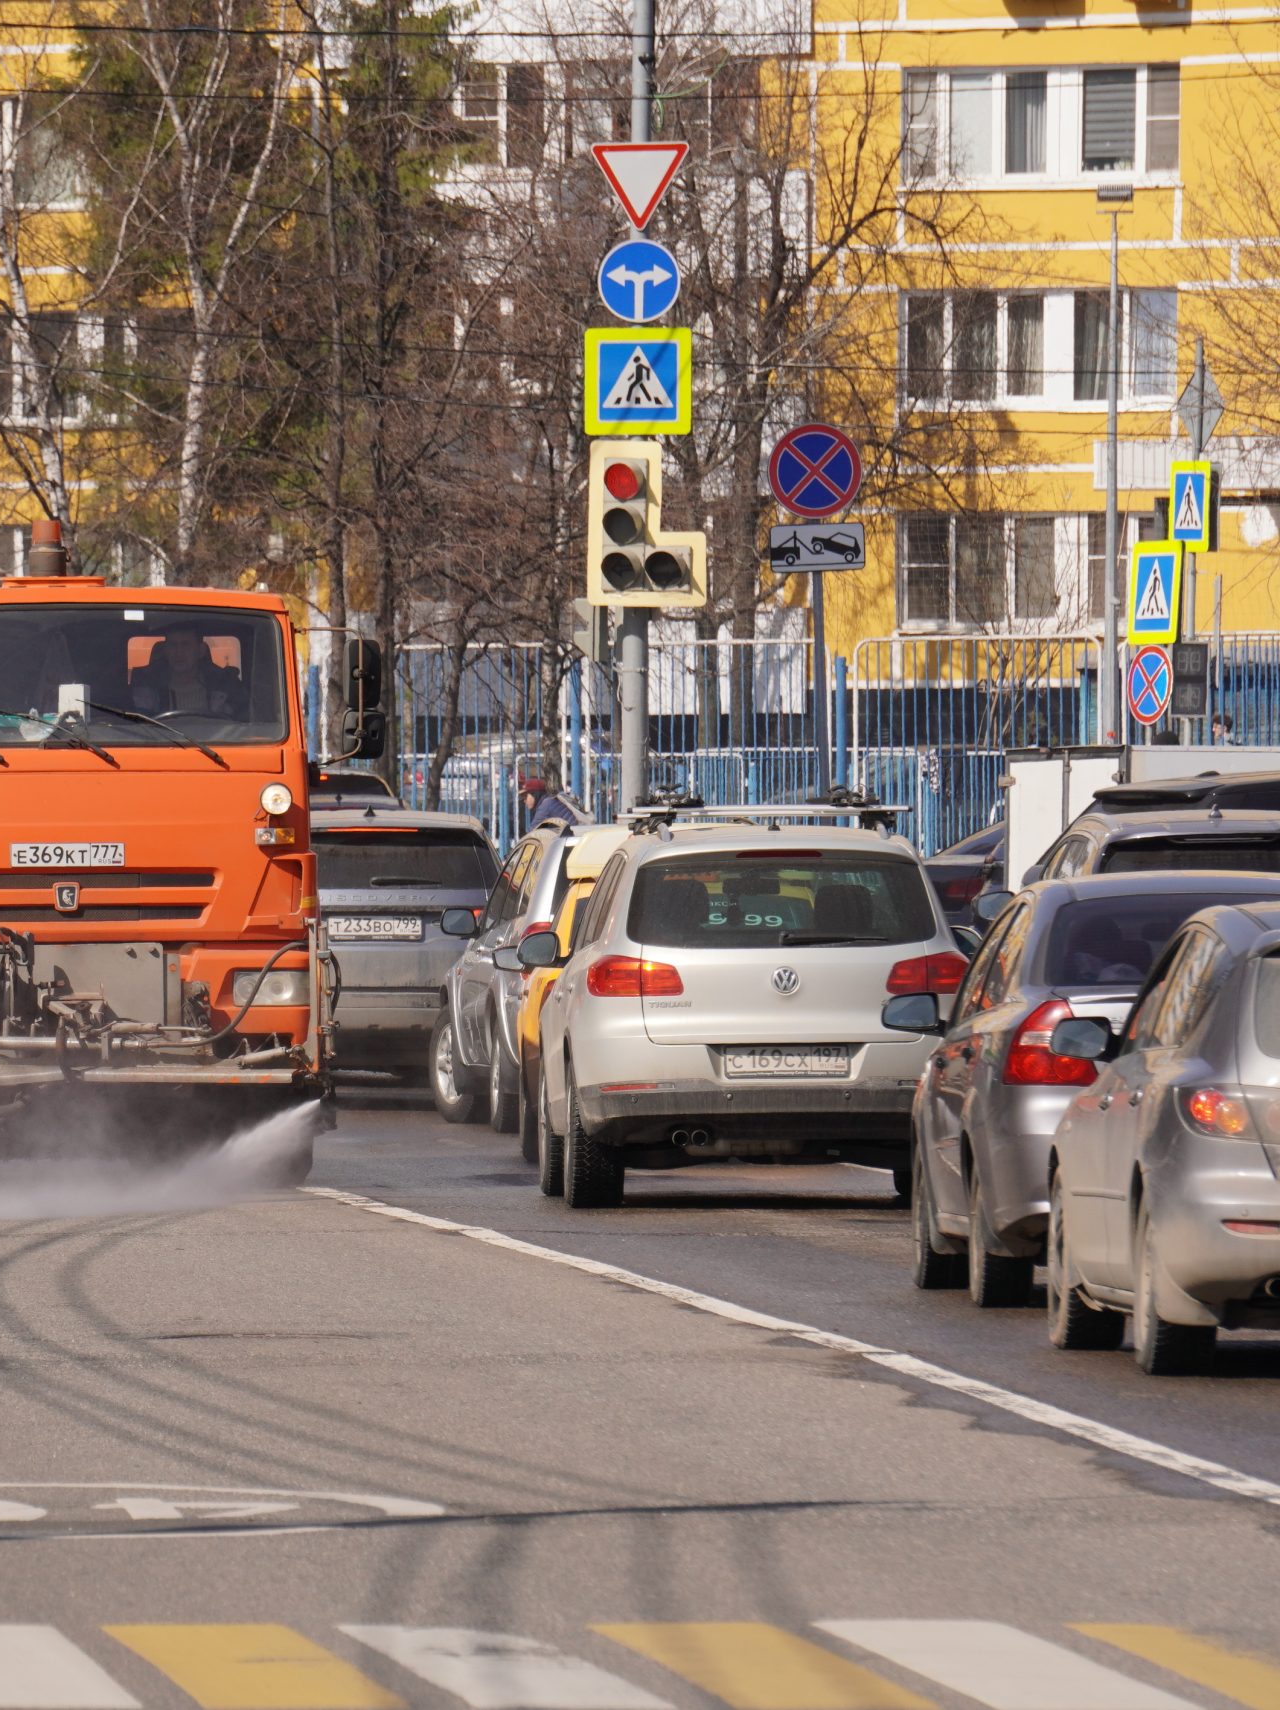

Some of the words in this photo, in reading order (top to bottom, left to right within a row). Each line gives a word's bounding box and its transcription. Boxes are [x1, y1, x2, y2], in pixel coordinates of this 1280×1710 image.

[91, 844, 119, 859] 777
[320, 894, 437, 902] ISCOVERY
[394, 917, 417, 929] 799
[813, 1047, 842, 1063] 197
